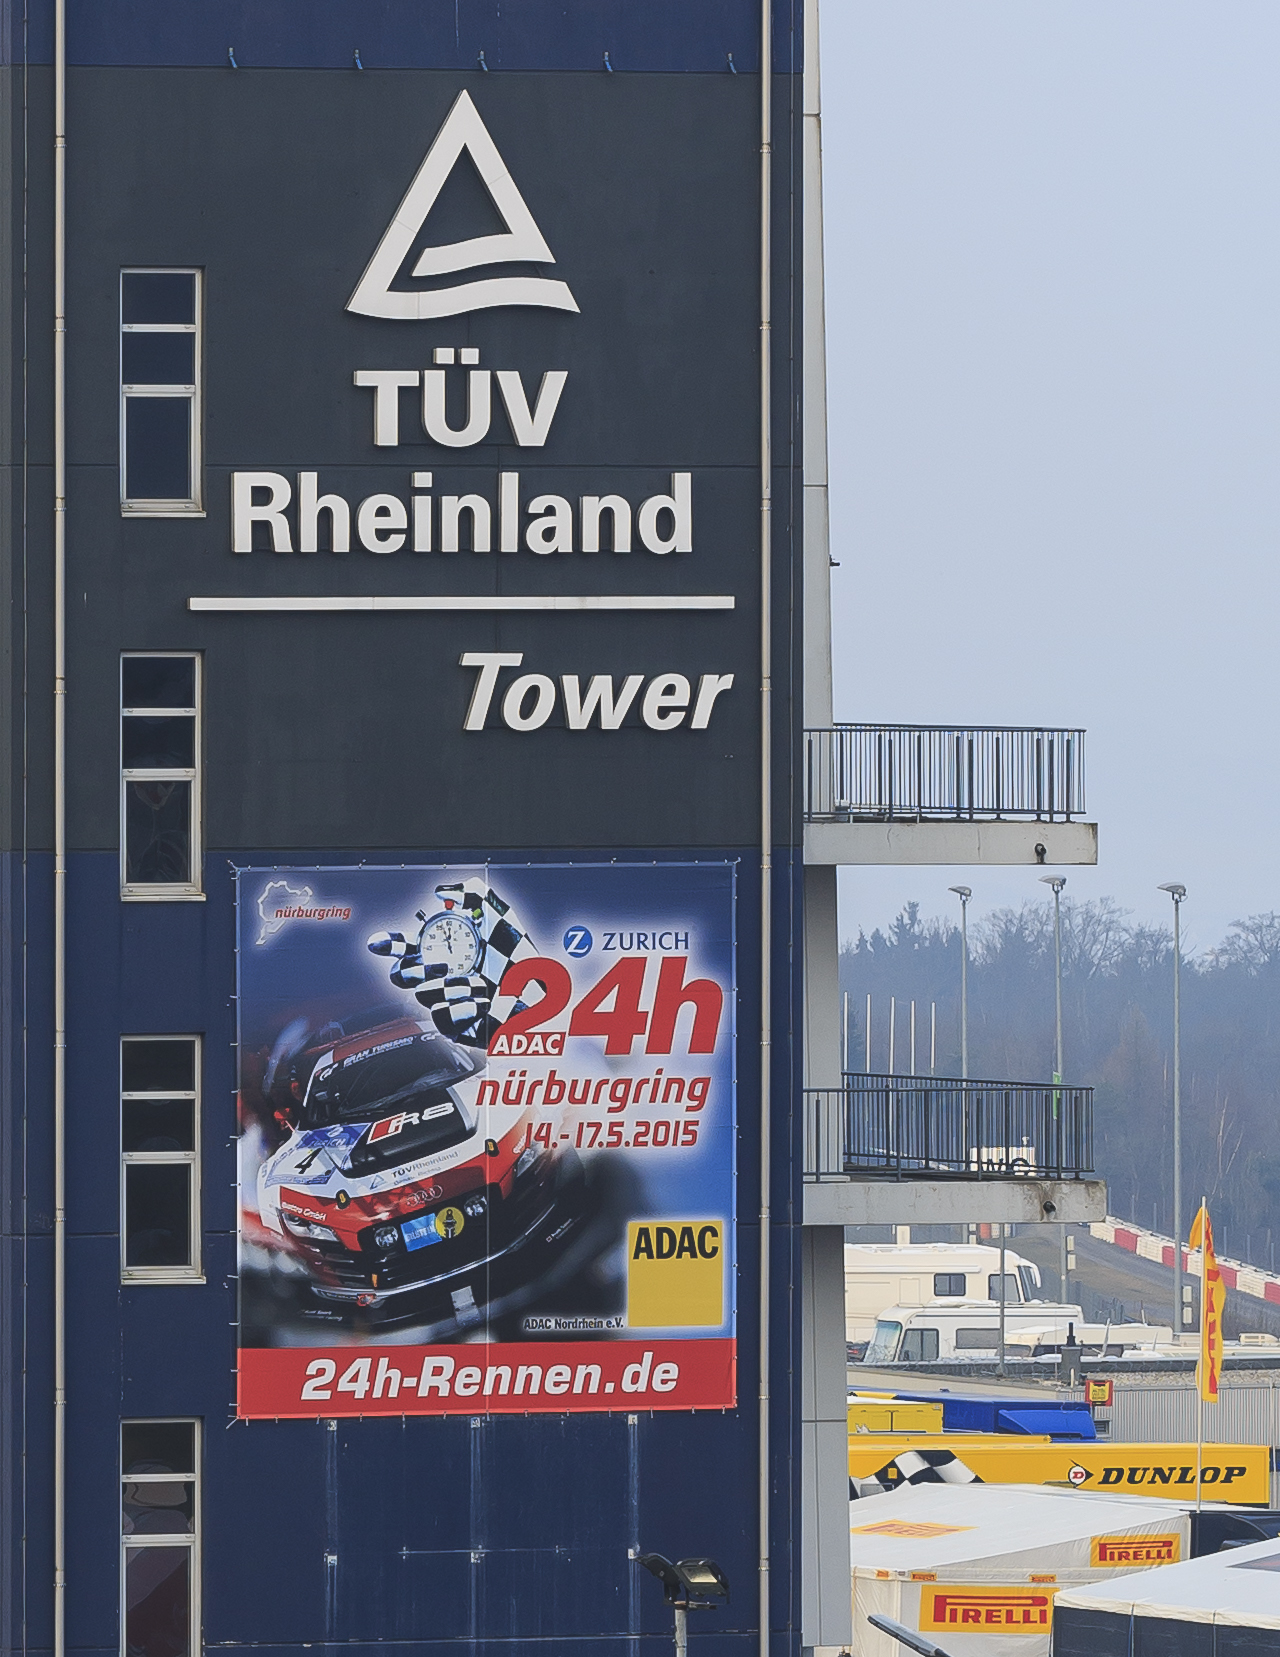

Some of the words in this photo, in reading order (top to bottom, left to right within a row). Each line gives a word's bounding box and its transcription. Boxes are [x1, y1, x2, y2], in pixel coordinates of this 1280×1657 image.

[354, 347, 568, 447] TÜV
[231, 471, 693, 555] Rheinland
[458, 652, 734, 732] Tower
[274, 905, 351, 921] nürburgring
[602, 931, 689, 951] ZURICH
[487, 956, 724, 1056] 24h
[492, 1034, 561, 1055] ADAC
[476, 1068, 711, 1113] nürburgring
[294, 1147, 324, 1175] 4
[632, 1225, 719, 1260] ADAC
[523, 1318, 551, 1330] ADAC
[554, 1316, 603, 1330] Nordrhein
[606, 1317, 624, 1329] e.V.
[300, 1351, 679, 1401] 24h-Rennen.de
[1098, 1466, 1247, 1485] DUNLOP
[1098, 1540, 1173, 1562] PIRELLI
[933, 1594, 1049, 1624] PIRELLI
